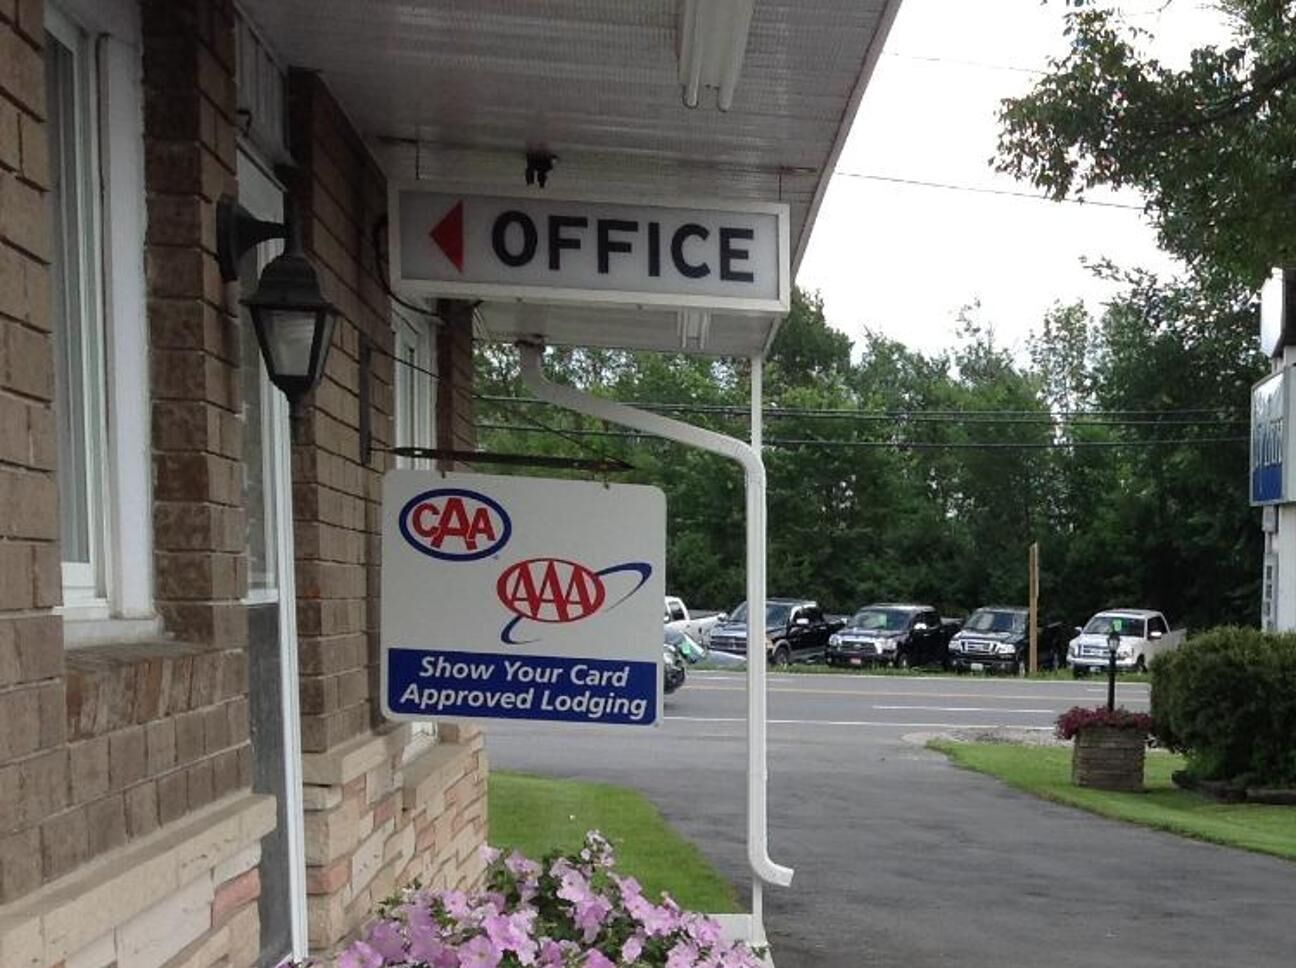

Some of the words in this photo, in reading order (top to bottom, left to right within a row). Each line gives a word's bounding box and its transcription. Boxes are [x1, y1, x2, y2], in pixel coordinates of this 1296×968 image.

[492, 210, 754, 283] OFFICE
[412, 497, 496, 550] CAA
[511, 561, 594, 621] AAA
[420, 656, 494, 680] Show
[504, 660, 563, 683] Your
[570, 664, 630, 687] Card
[400, 683, 534, 710] Approved
[541, 689, 647, 720] Lodging
